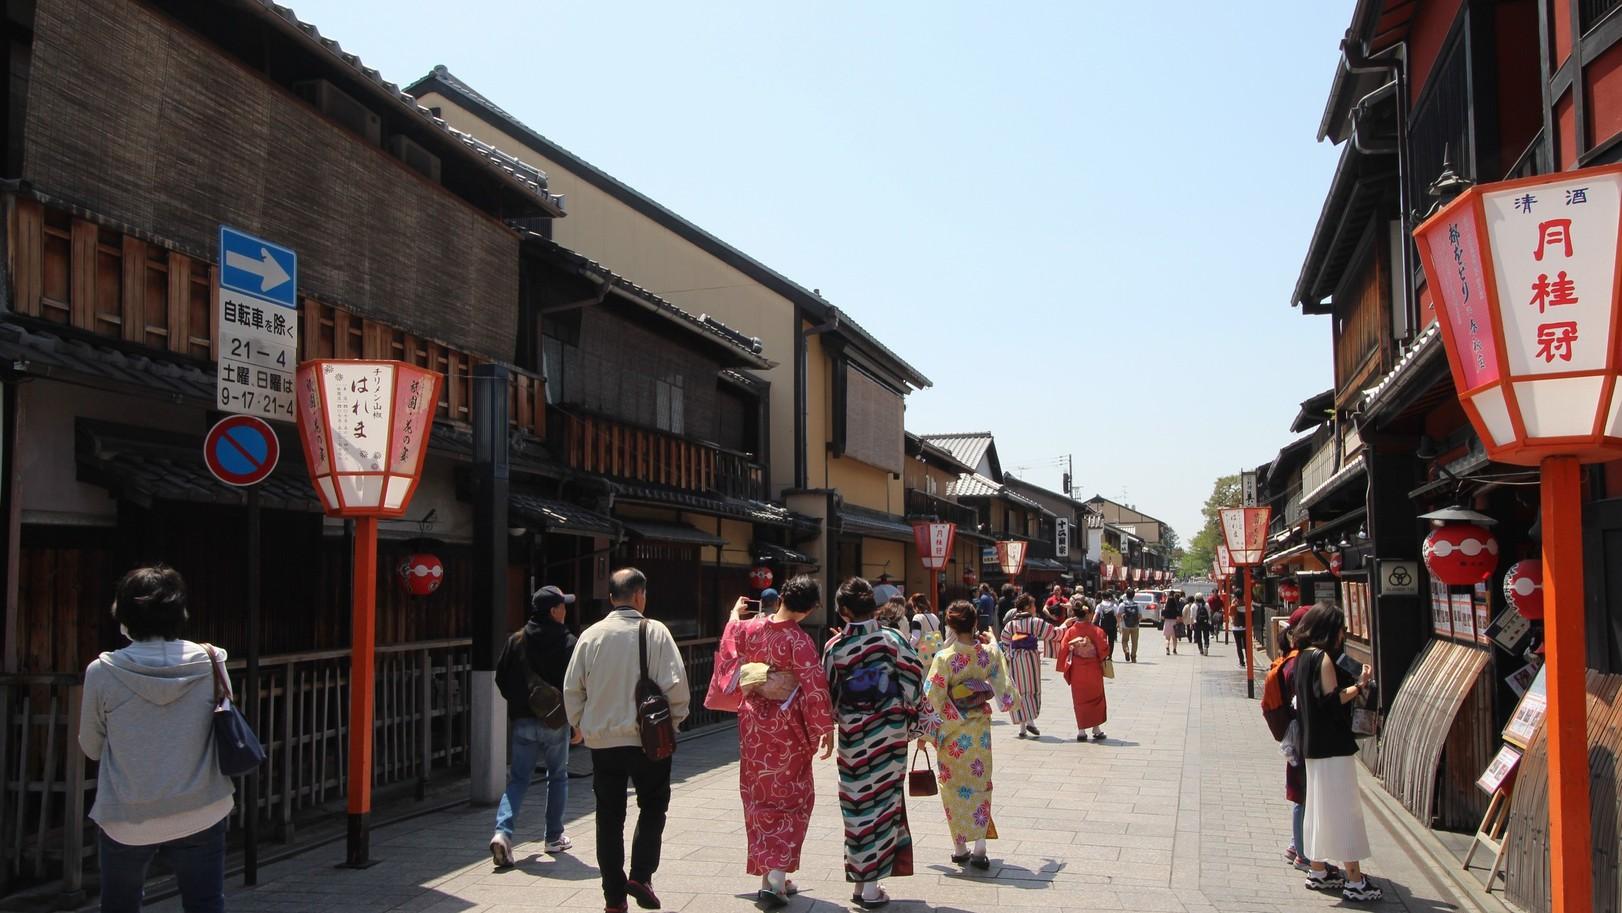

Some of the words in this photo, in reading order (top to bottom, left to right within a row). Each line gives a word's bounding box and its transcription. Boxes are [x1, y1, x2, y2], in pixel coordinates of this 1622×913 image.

[1514, 187, 1589, 214] 清酒
[1529, 218, 1579, 363] 月桂冠
[224, 300, 293, 338] 自転車を除く
[222, 364, 293, 394] 土曜、日曜は
[373, 368, 382, 419] チリメン山椒
[351, 376, 369, 438] はれま
